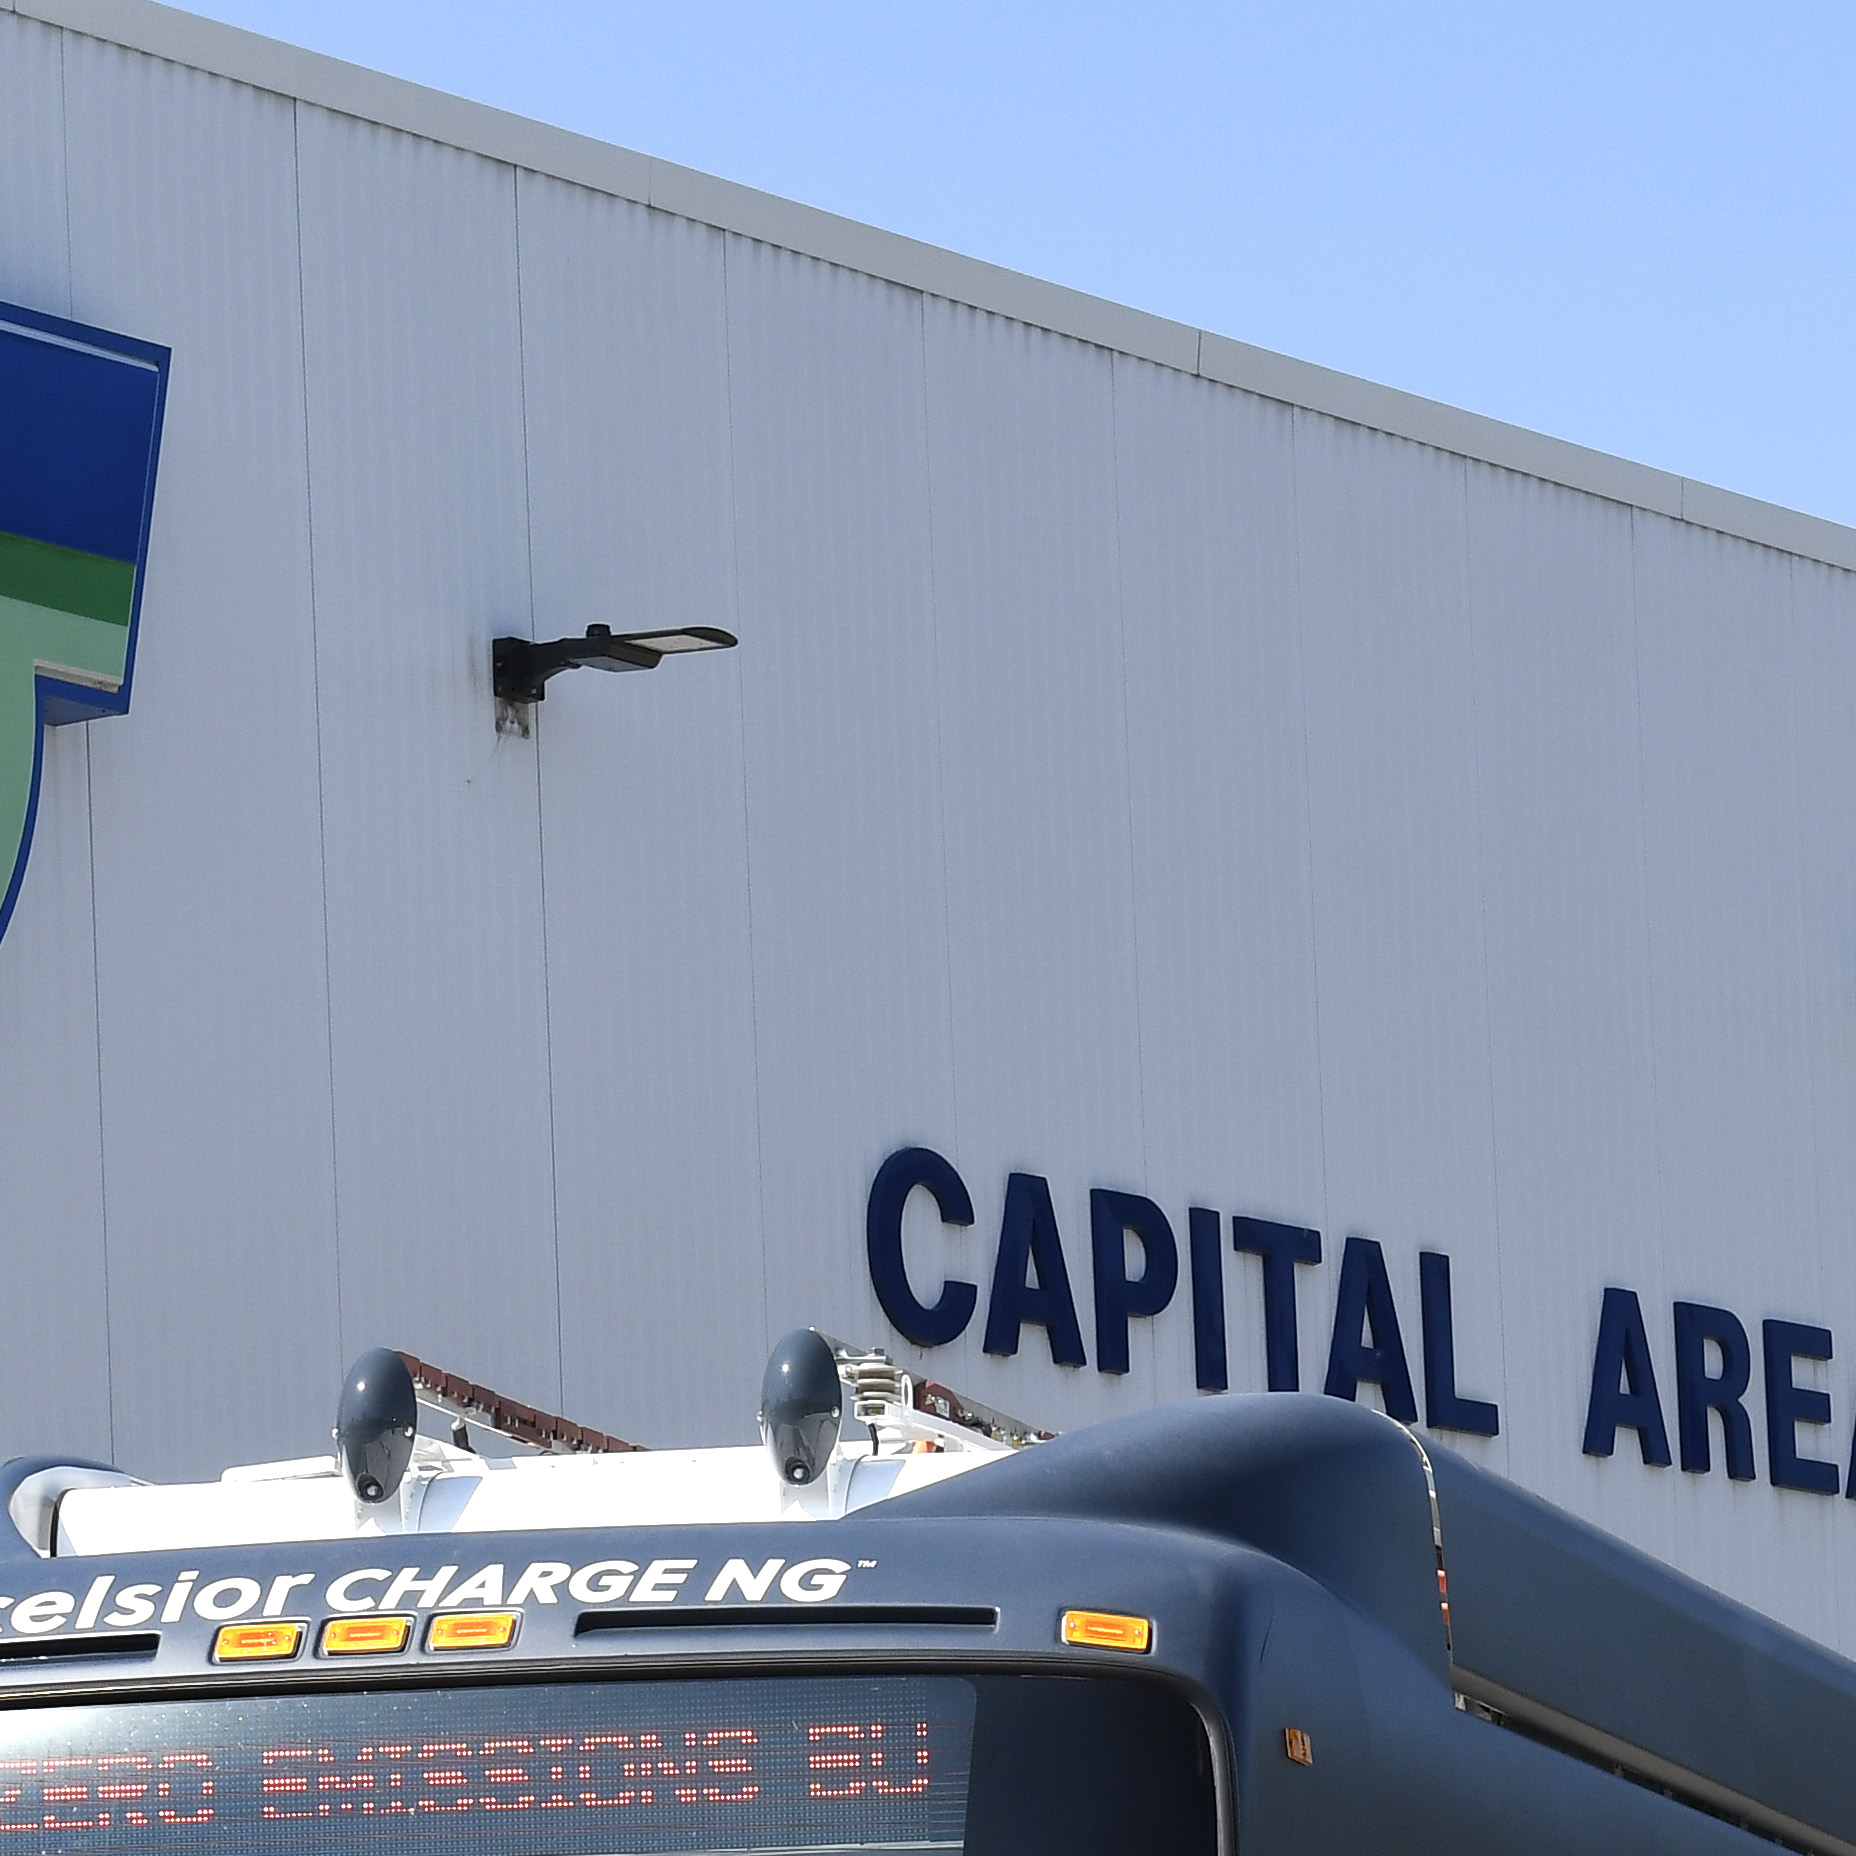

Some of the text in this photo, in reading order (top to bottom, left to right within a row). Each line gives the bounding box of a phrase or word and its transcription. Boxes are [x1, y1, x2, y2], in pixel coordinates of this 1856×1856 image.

[866, 1145, 1499, 1438] CAPITAL
[325, 1560, 698, 1612] CHARGE
[262, 1730, 759, 1819] EMISSIONS
[809, 1722, 930, 1797] BU
